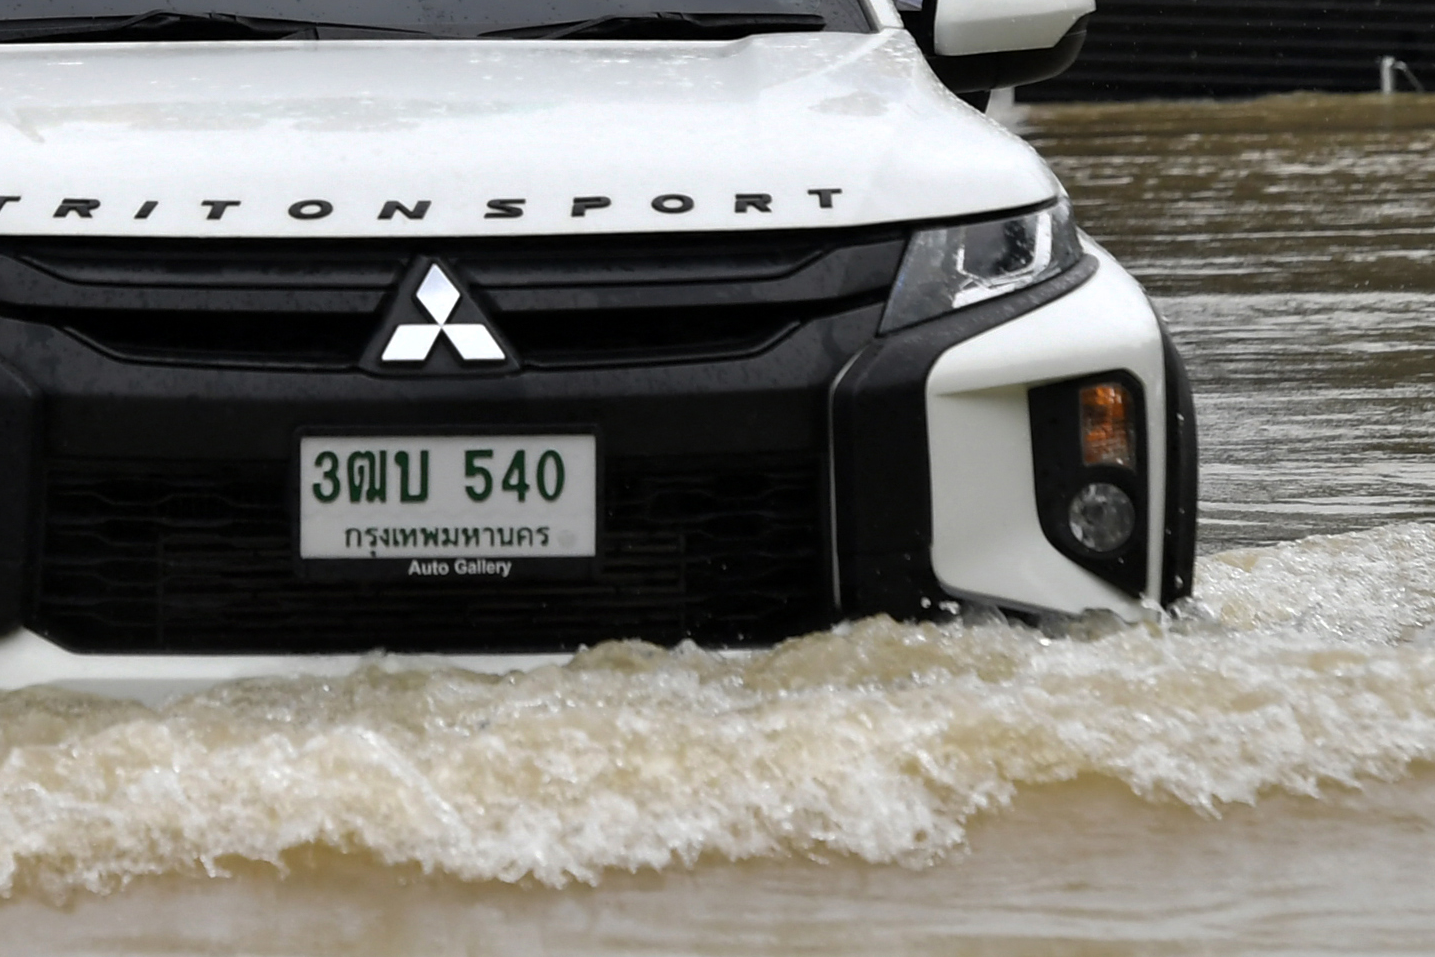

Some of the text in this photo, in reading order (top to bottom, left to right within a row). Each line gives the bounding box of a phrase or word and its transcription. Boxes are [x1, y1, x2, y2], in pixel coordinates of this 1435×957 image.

[483, 188, 843, 219] SPORT
[312, 448, 565, 503] 3ฒบ 540
[345, 525, 551, 558] กรุงเทพมหานคร
[408, 559, 513, 578] Auto Gallery
